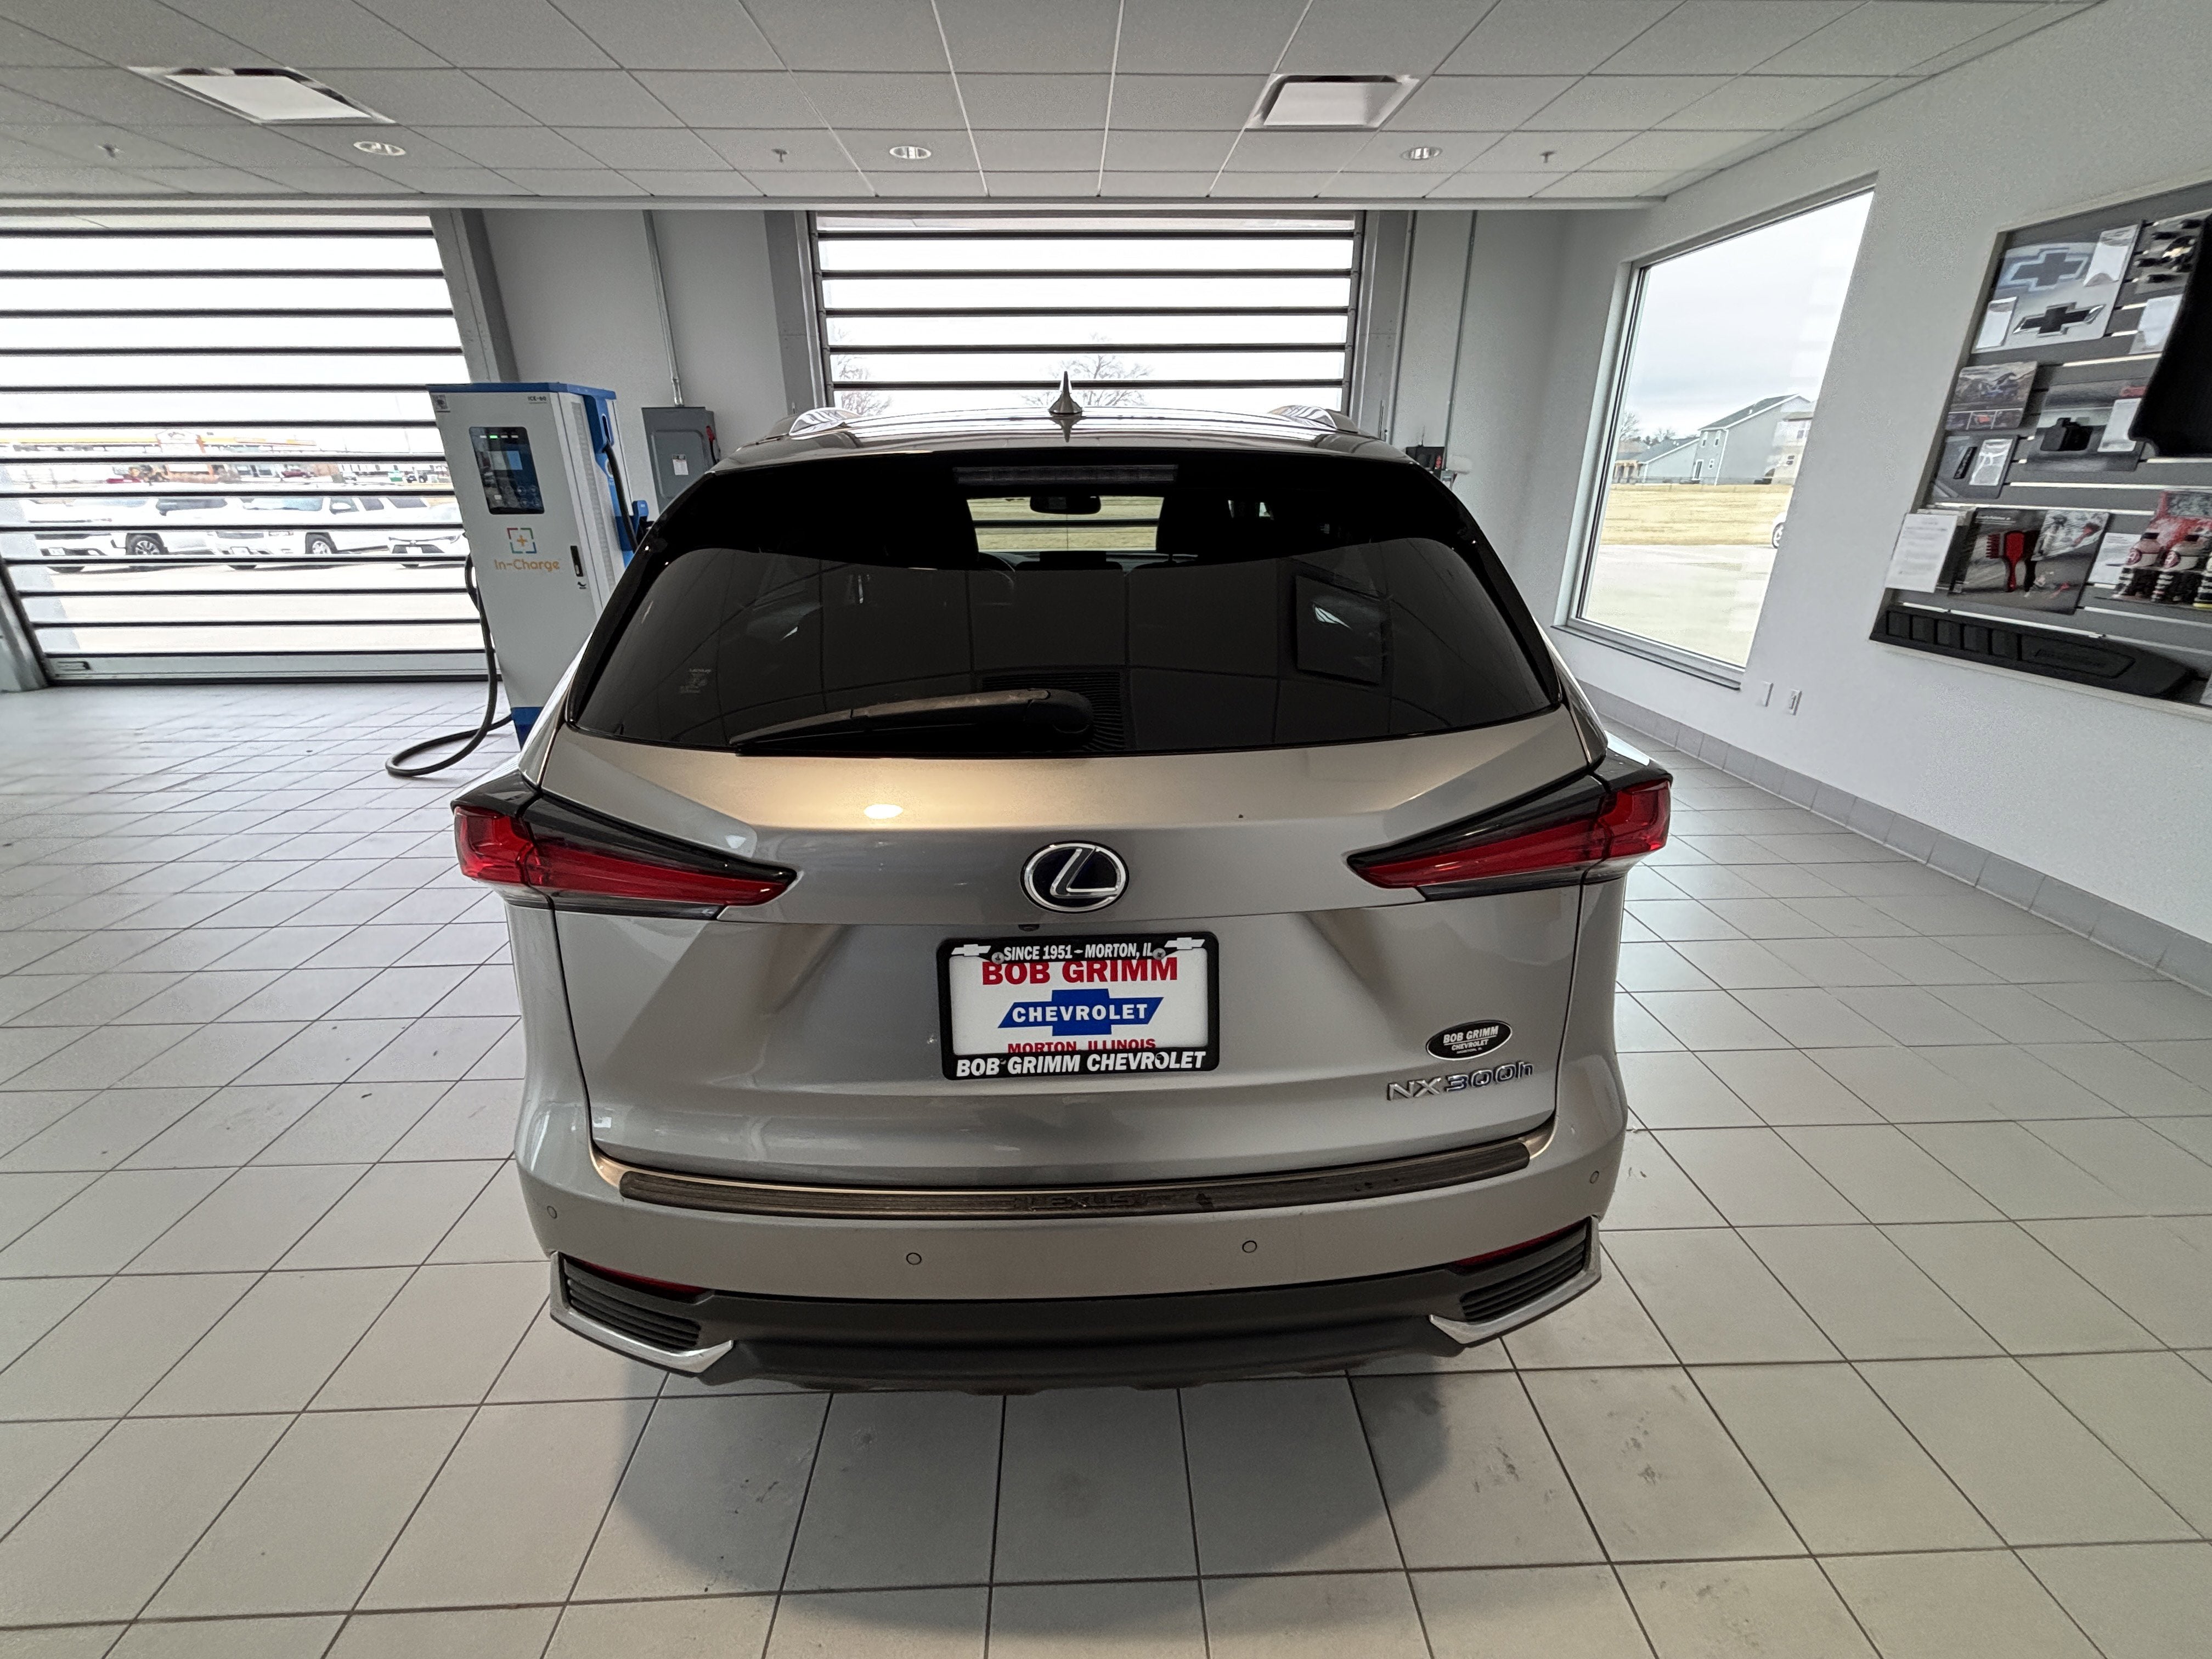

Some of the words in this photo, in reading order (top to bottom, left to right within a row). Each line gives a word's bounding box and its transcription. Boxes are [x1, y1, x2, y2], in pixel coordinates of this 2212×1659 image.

[494, 558, 560, 572] In-Charge
[1003, 946, 1040, 961] SINCE
[1042, 945, 1073, 960] 1951
[1085, 943, 1140, 960] MORTON,
[1142, 943, 1153, 957] IL
[983, 961, 1050, 985] BOB
[1062, 957, 1177, 983] GRIMM
[1012, 1004, 1148, 1023] CHEVROLET
[1443, 1032, 1464, 1043] BOB
[1466, 1025, 1499, 1040] GRIMM
[1088, 1039, 1156, 1050] ILLINOIS
[1451, 1039, 1489, 1051] CHEVROLET
[956, 1058, 1000, 1077] BOB
[1007, 1055, 1080, 1074] GRIMM
[1087, 1052, 1206, 1071] CHEVROLET
